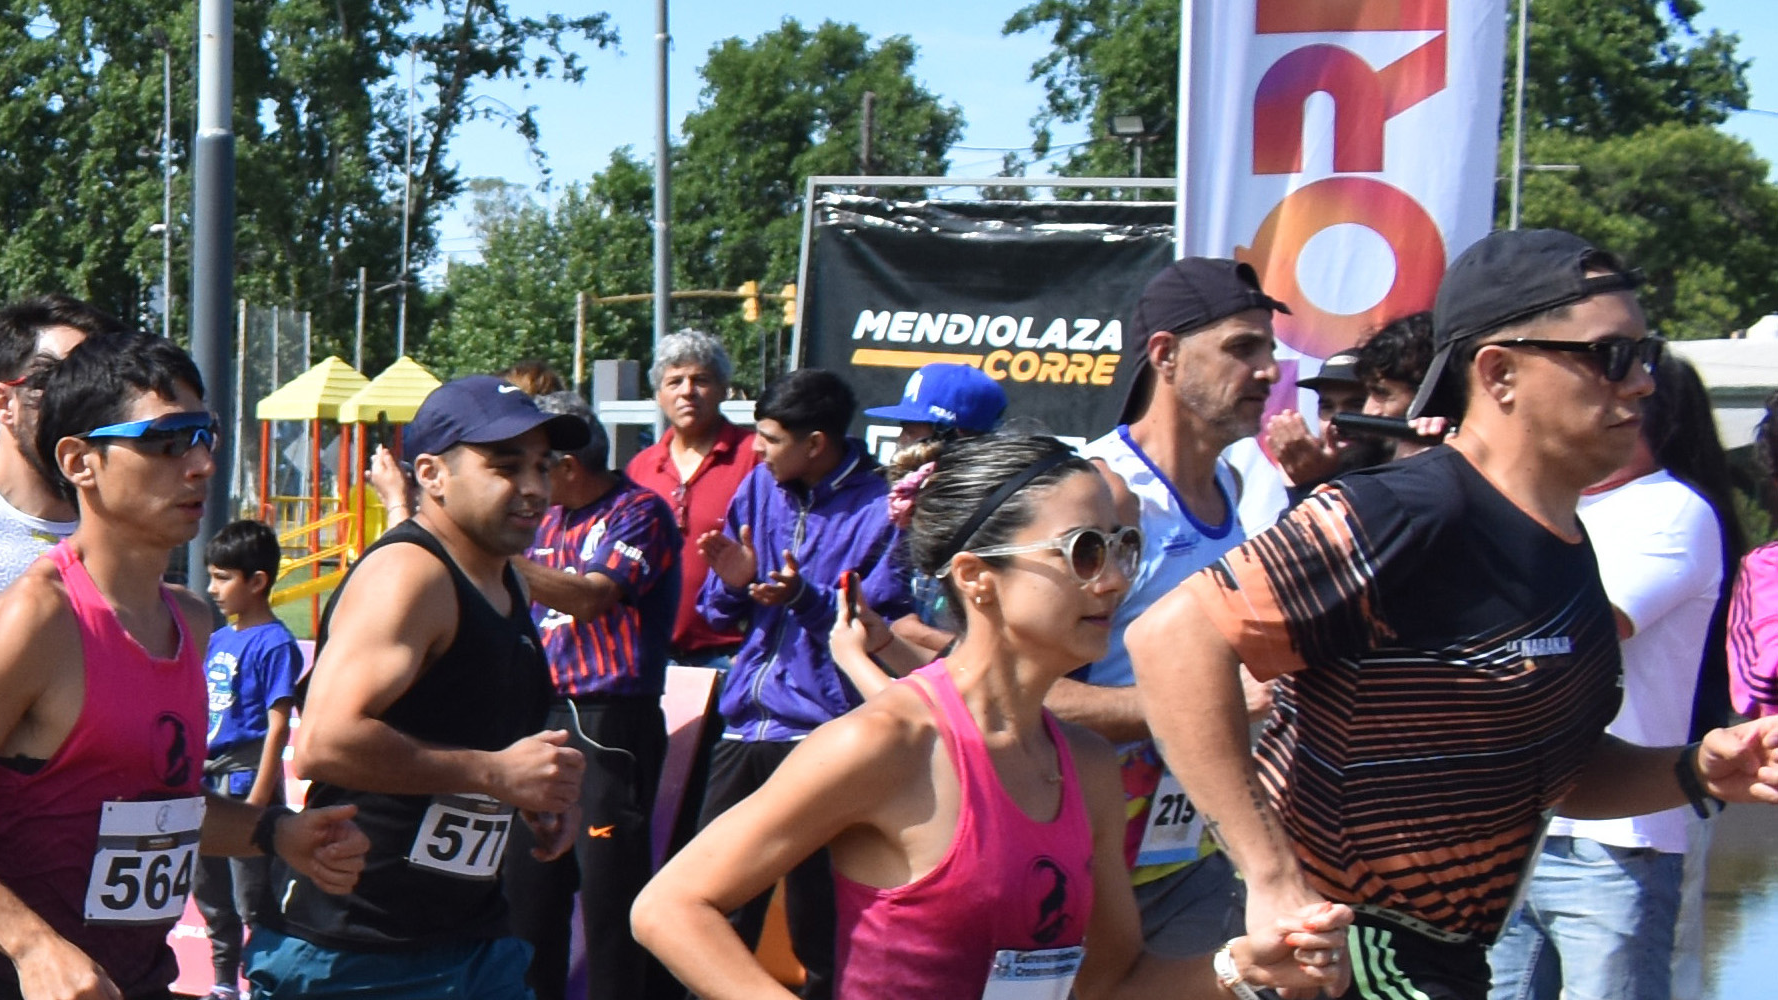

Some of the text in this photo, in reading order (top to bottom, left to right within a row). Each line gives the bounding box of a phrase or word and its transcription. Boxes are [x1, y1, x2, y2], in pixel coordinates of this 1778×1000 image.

[851, 309, 1123, 351] MENDIOLAZA
[983, 349, 1122, 386] CORRE
[100, 849, 194, 911] 564
